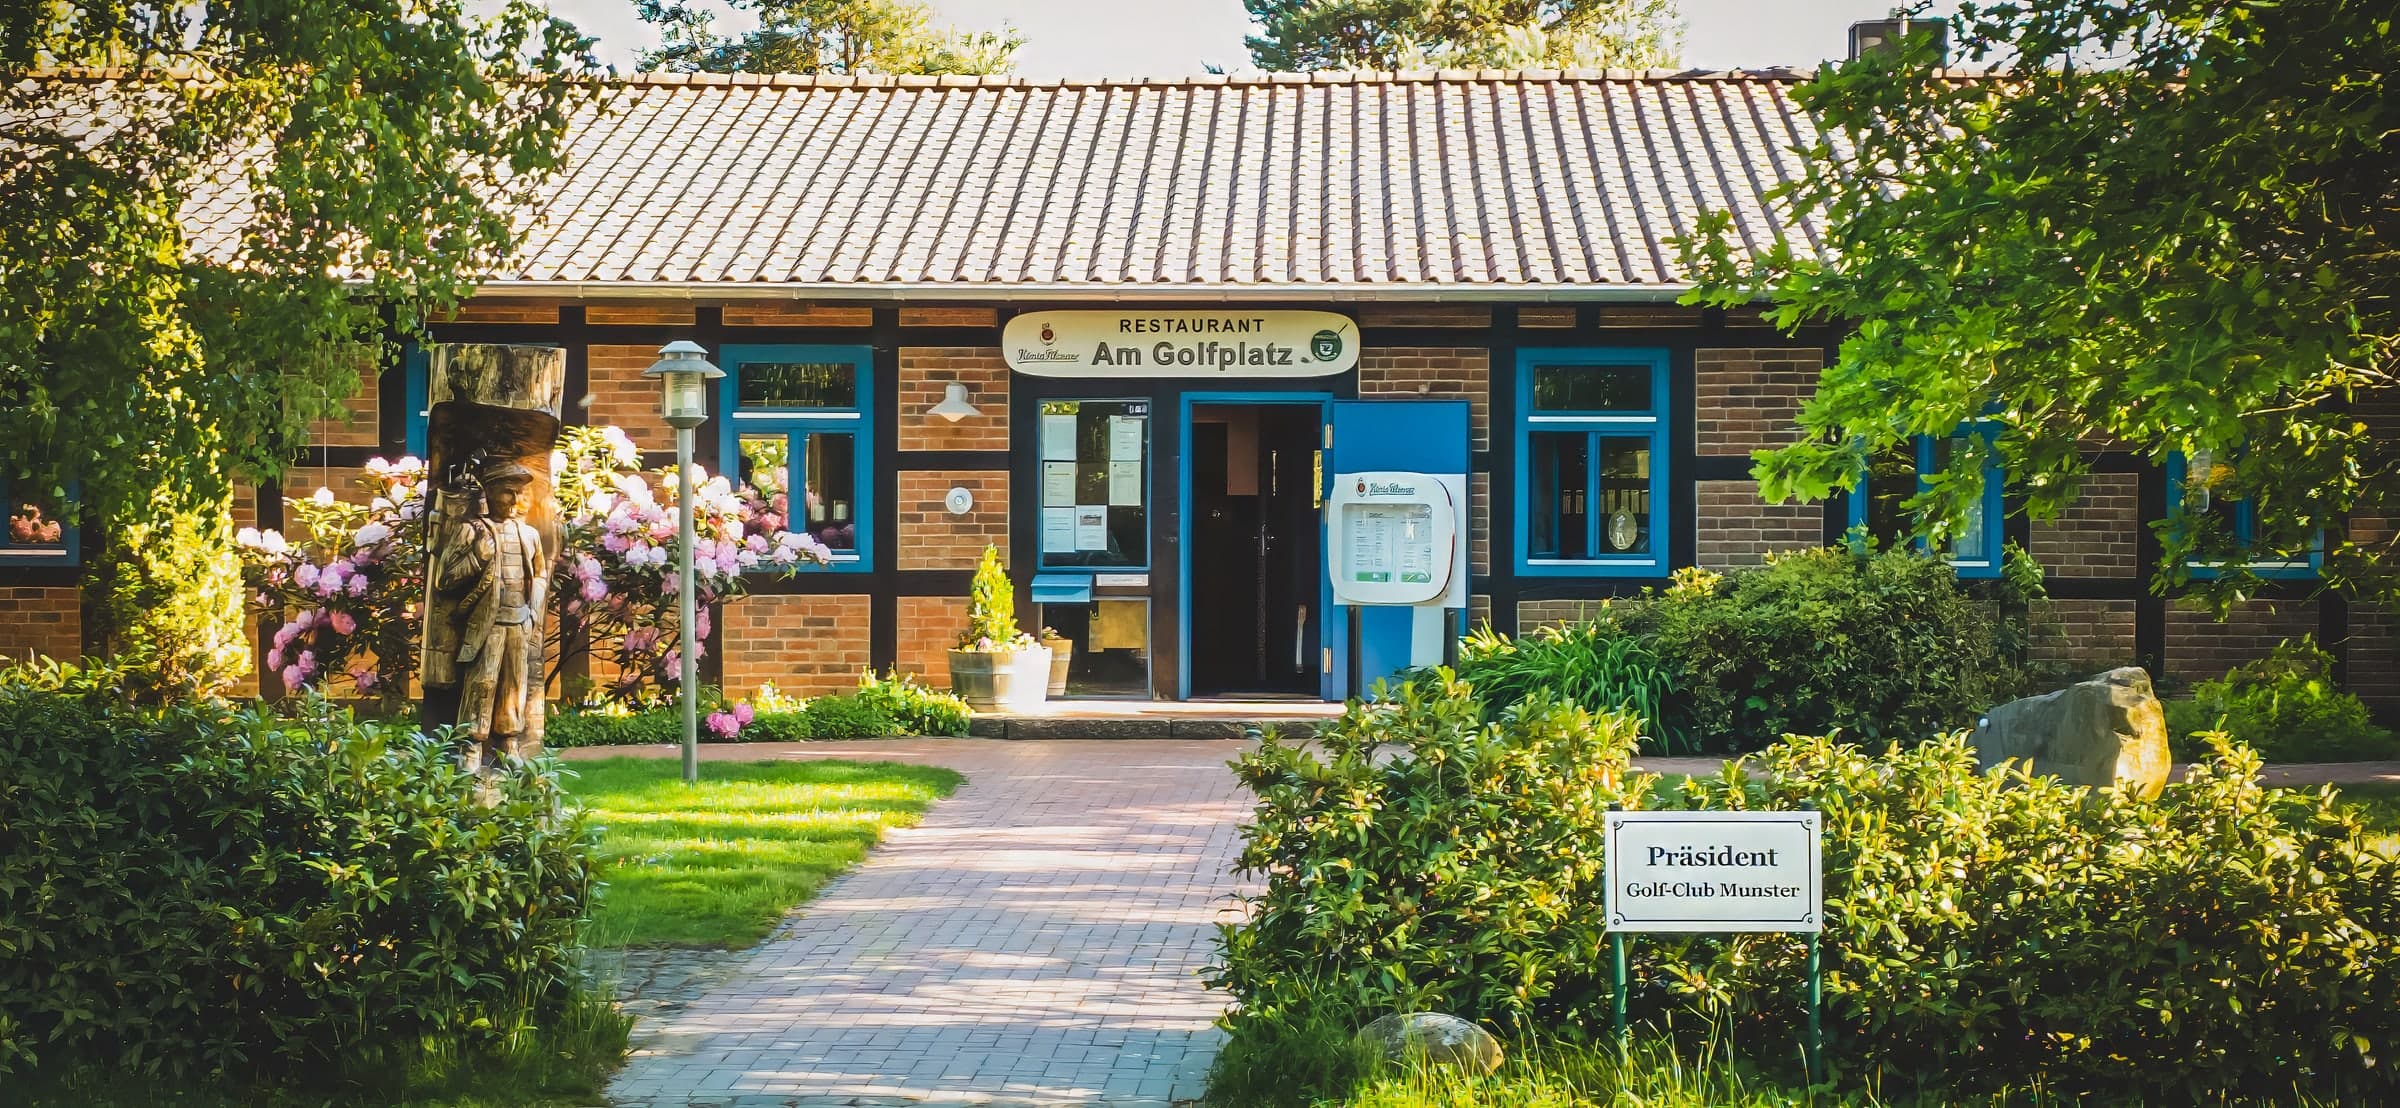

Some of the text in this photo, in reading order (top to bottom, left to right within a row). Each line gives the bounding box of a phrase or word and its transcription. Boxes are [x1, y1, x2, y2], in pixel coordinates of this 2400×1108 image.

[1119, 318, 1265, 333] RESTAURANT
[1091, 341, 1293, 371] Am Golfplatz
[1646, 845, 1779, 867] Präsident
[1626, 882, 1801, 898] Golf-Club Munster
